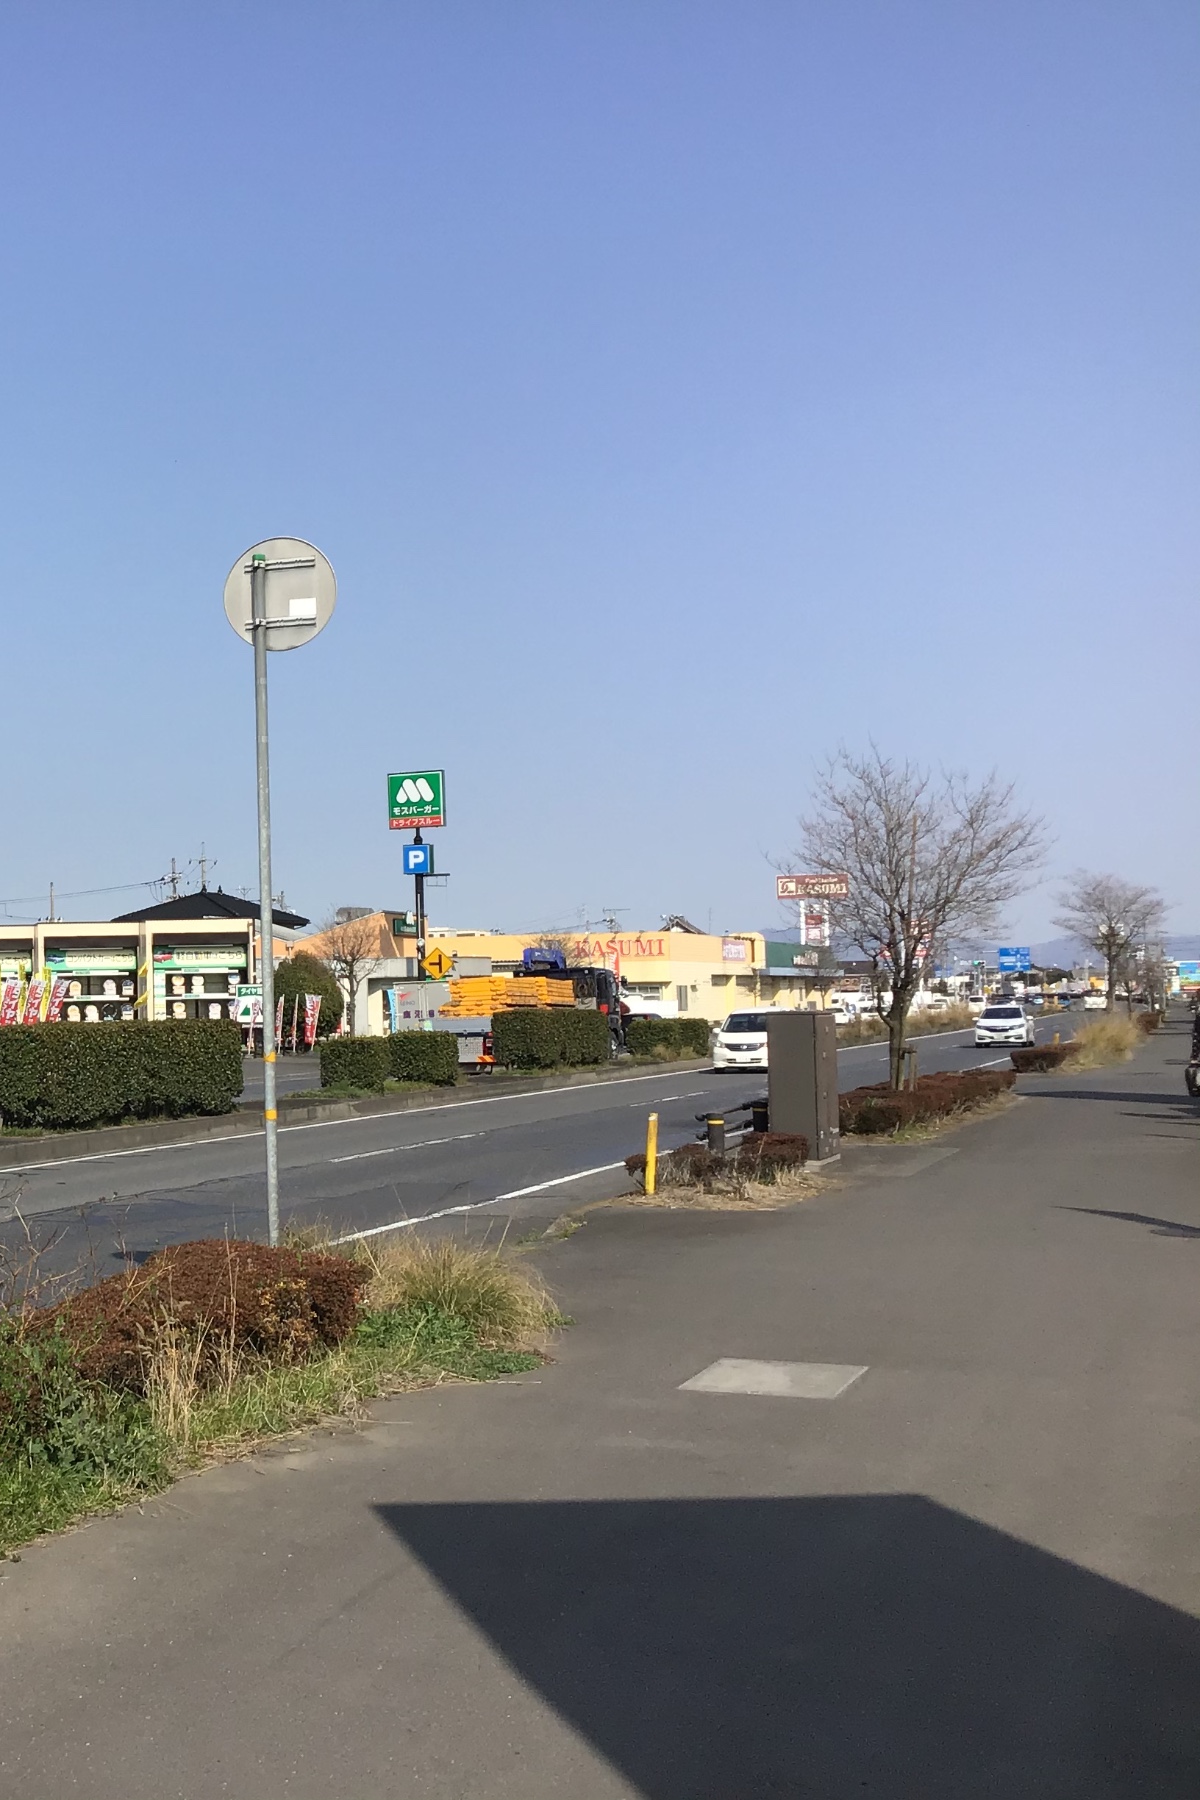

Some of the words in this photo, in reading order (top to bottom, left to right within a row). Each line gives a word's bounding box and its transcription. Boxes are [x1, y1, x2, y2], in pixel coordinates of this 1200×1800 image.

[393, 805, 440, 816] モスバーガー
[392, 818, 440, 827] ドライブスルー
[408, 850, 425, 869] P
[796, 883, 847, 895] KASUMI
[574, 938, 664, 958] KASUMI
